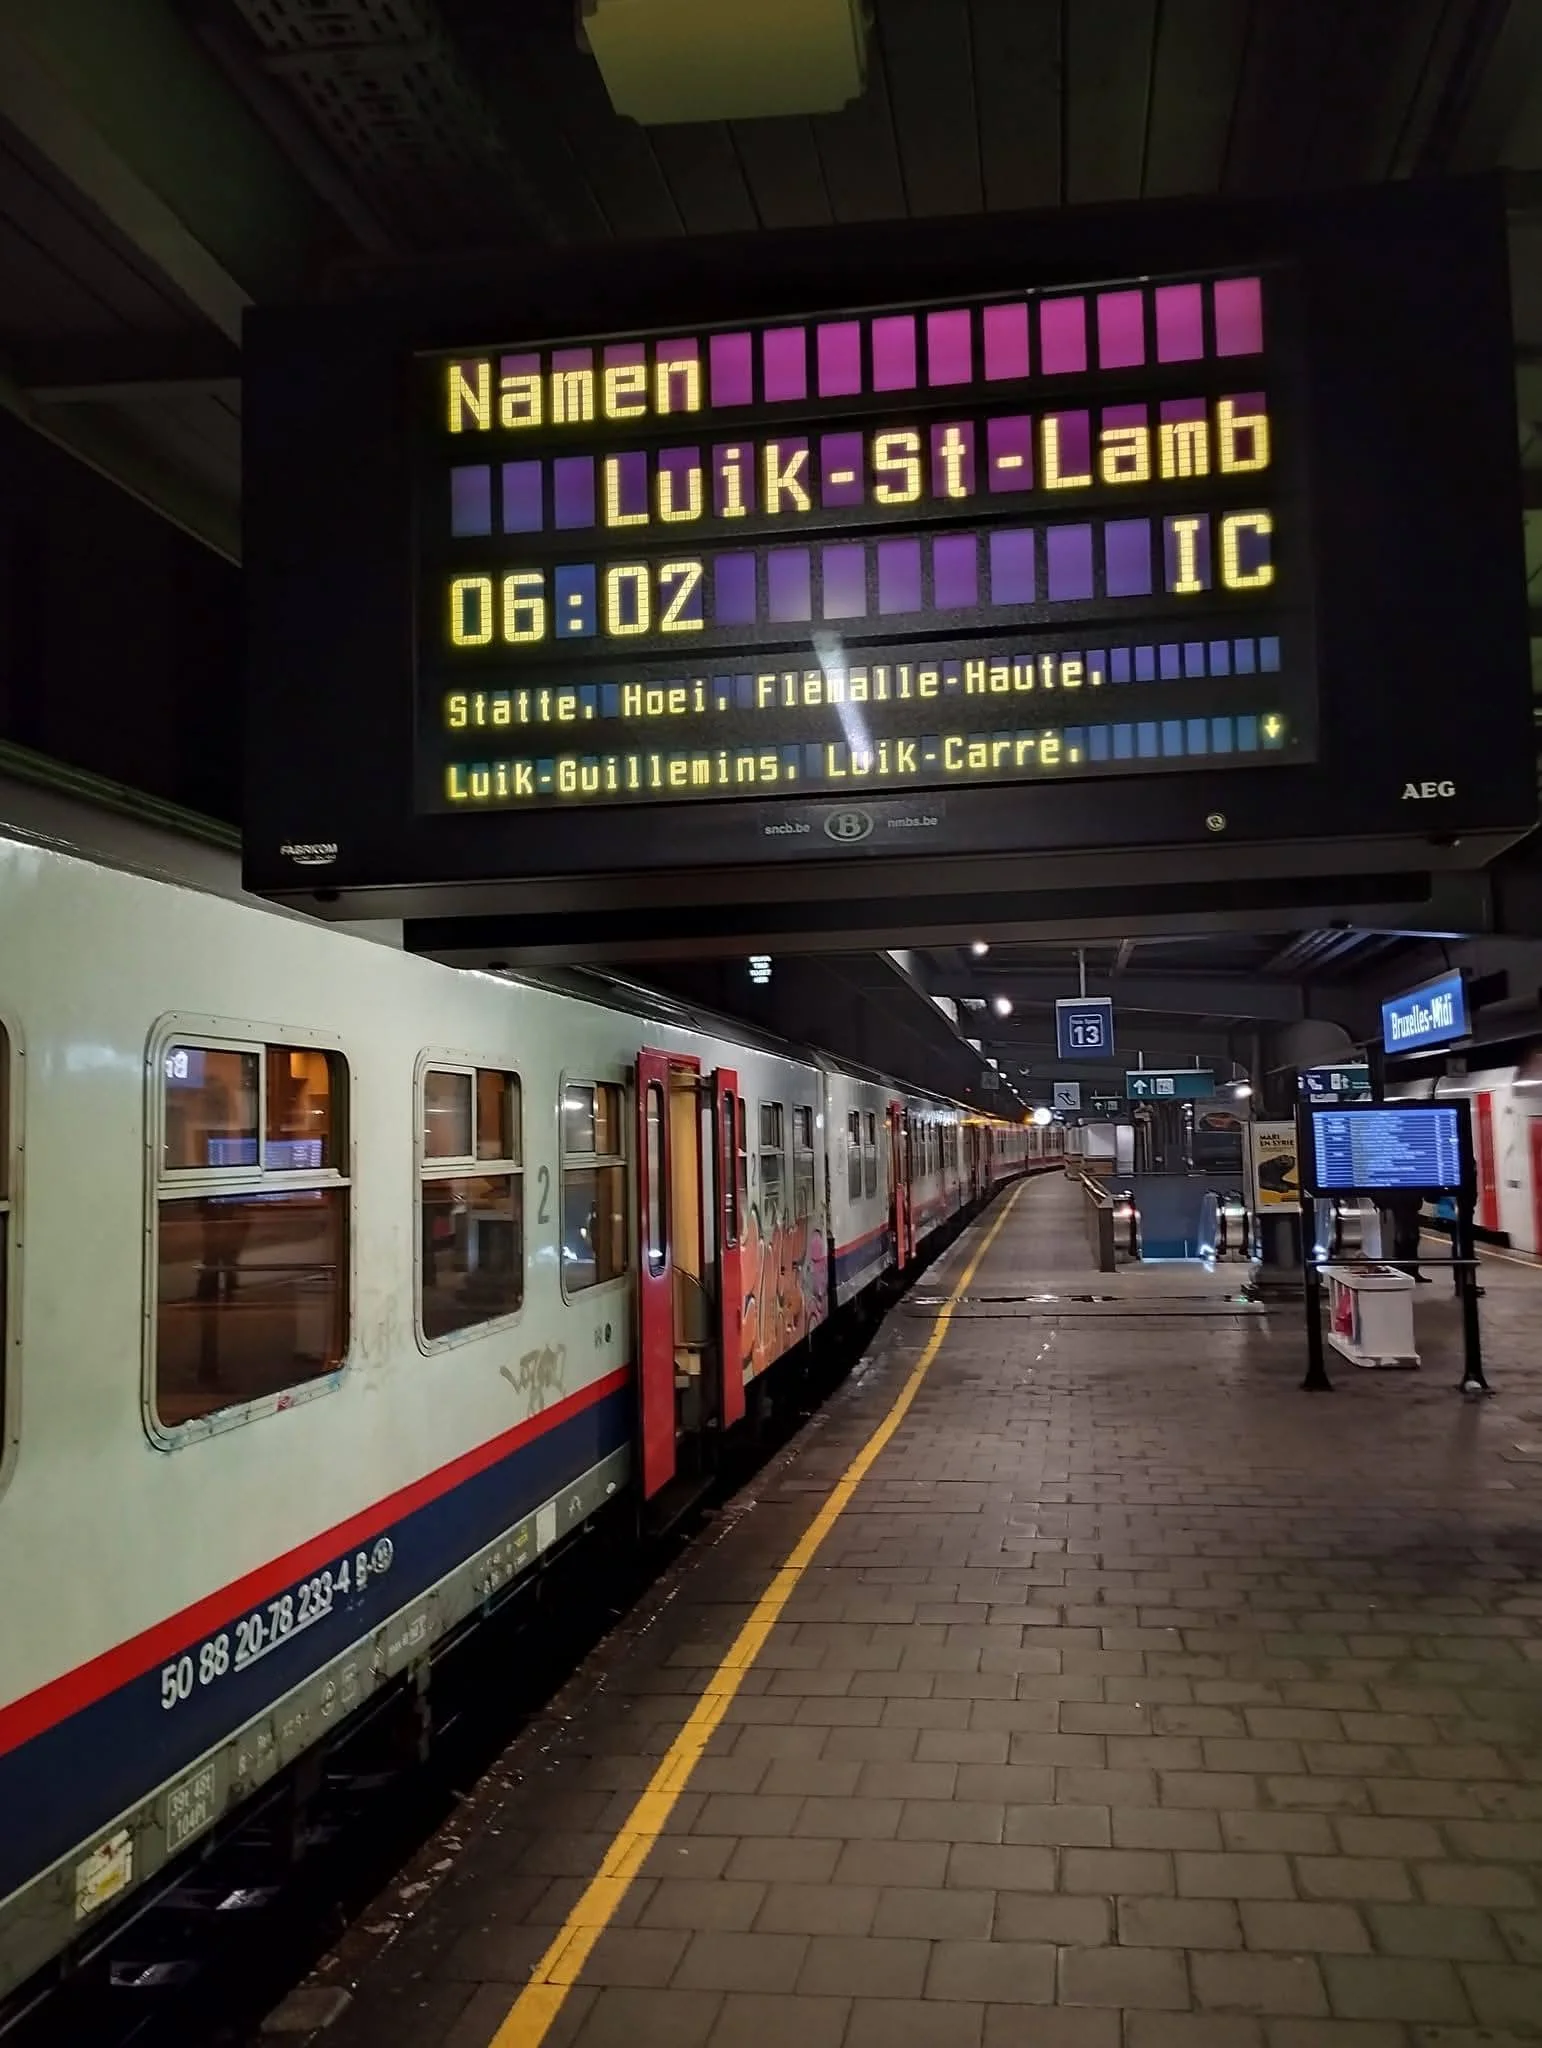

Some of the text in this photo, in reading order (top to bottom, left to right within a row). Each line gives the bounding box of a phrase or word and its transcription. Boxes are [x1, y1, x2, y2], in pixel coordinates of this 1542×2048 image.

[448, 358, 700, 433] Namen
[605, 400, 1270, 527] Luik-St-Lamb
[451, 514, 1274, 645] 06:02 IC
[1401, 780, 1456, 799] AEG
[765, 823, 811, 835] sncb.be
[888, 816, 938, 828] nmbs.be
[1074, 1025, 1099, 1044] 13
[1391, 993, 1453, 1040] Bruxelles-Midi
[537, 1164, 550, 1225] 2
[161, 1655, 193, 1710] 50
[199, 1633, 230, 1685] 88
[234, 1594, 293, 1661] 20-78
[297, 1559, 350, 1622] 233-4
